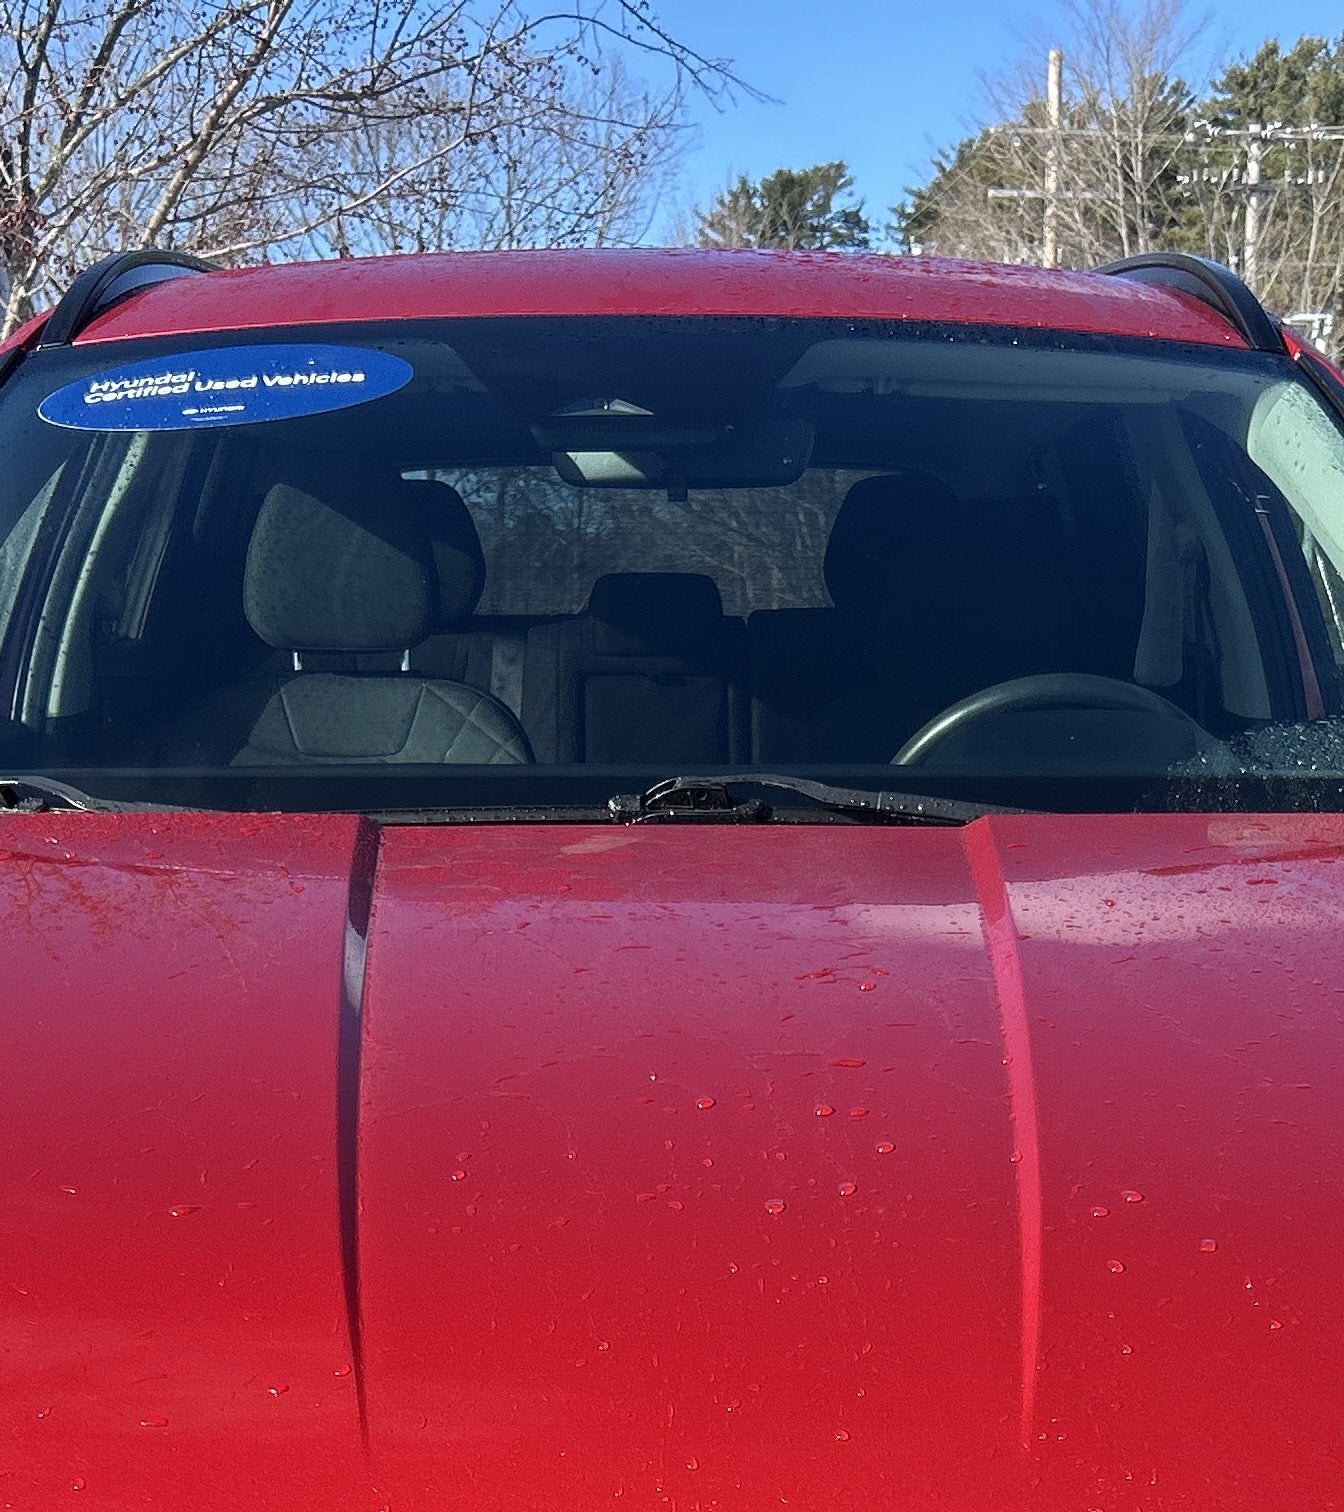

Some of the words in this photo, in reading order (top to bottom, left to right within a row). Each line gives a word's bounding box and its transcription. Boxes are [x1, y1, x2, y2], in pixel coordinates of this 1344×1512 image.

[84, 382, 191, 404] Certified
[194, 377, 258, 392] Used
[262, 372, 366, 388] Vehicles
[89, 371, 196, 393] Hyundai
